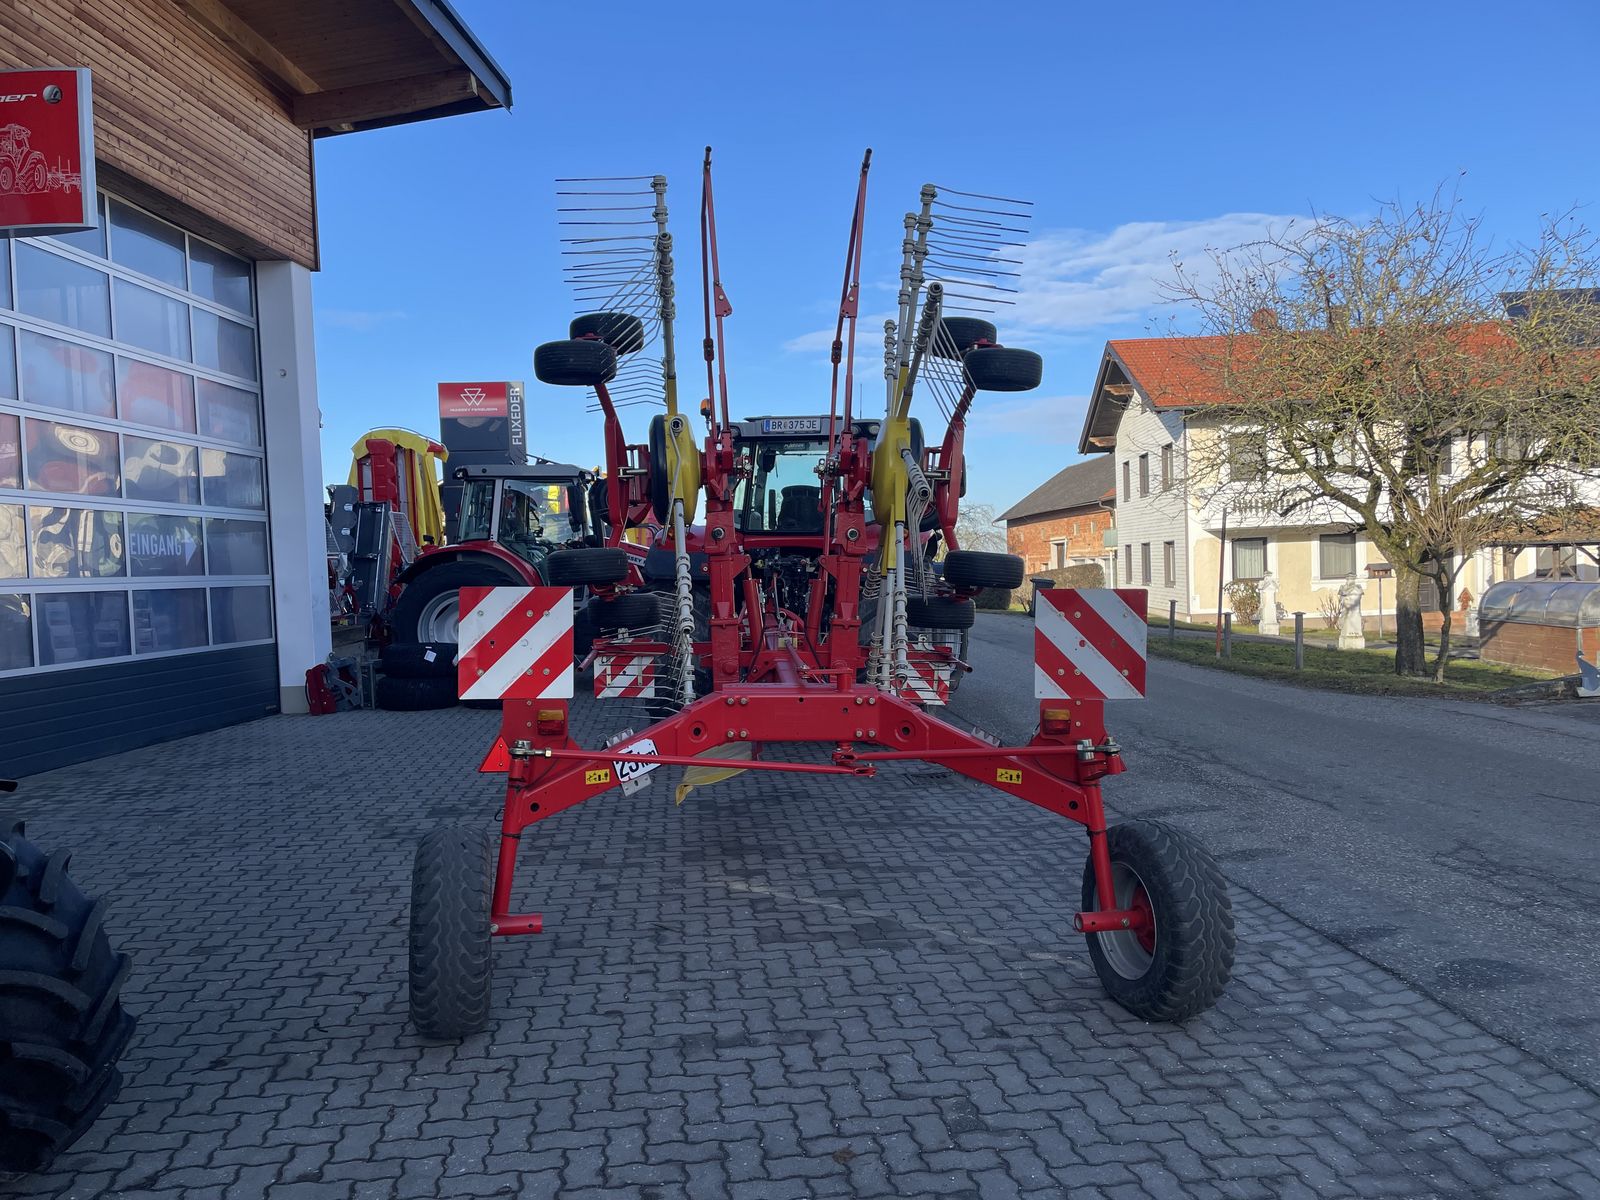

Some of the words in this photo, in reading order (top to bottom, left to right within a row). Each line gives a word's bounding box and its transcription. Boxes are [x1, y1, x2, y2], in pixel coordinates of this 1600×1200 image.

[510, 387, 523, 445] FLIXEDER
[771, 421, 783, 430] BR
[129, 532, 182, 556] EINGANG
